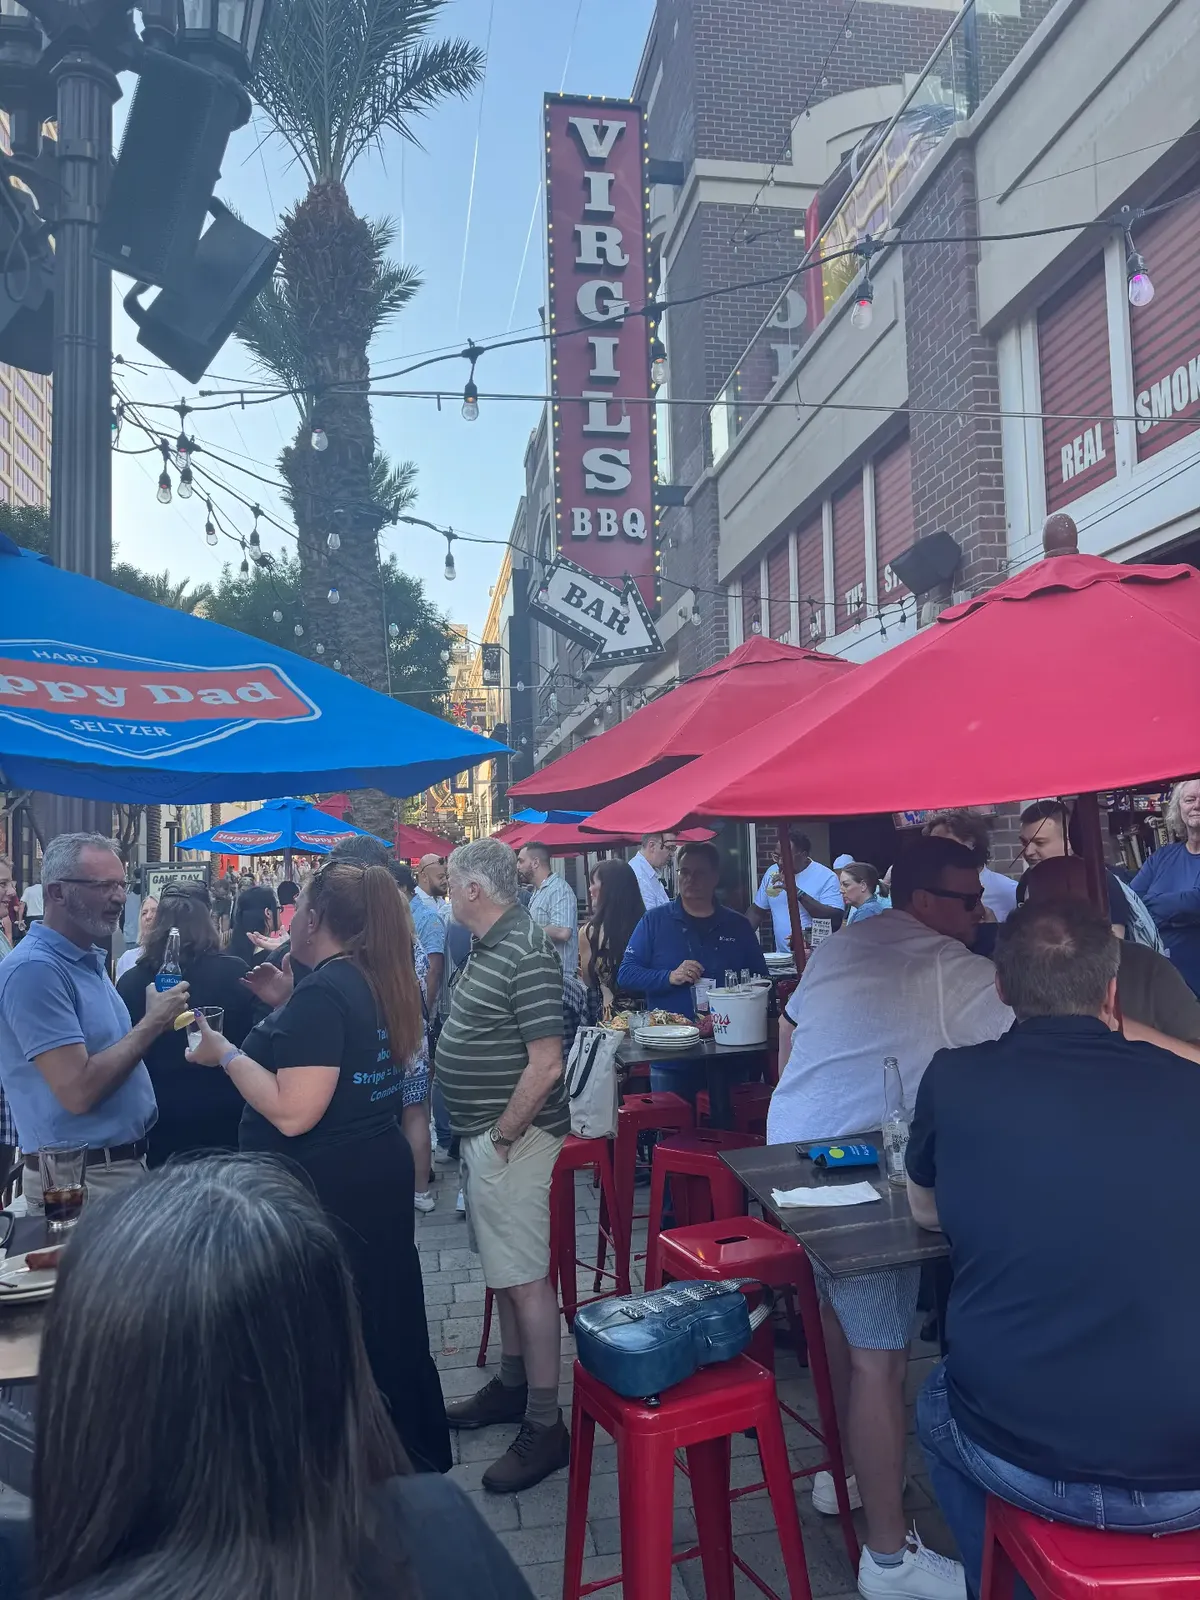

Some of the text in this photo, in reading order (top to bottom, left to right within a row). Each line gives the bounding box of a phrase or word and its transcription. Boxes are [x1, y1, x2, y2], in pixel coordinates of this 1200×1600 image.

[567, 116, 632, 491] VIRGILS
[1061, 422, 1107, 483] REAL
[571, 507, 648, 539] BBQ
[561, 582, 632, 636] BAR
[845, 582, 864, 617] THE
[31, 649, 99, 664] HARD
[140, 681, 283, 705] Dad
[69, 718, 172, 737] SELTZER
[217, 832, 279, 844] Happy Dad
[152, 874, 178, 884] GAME
